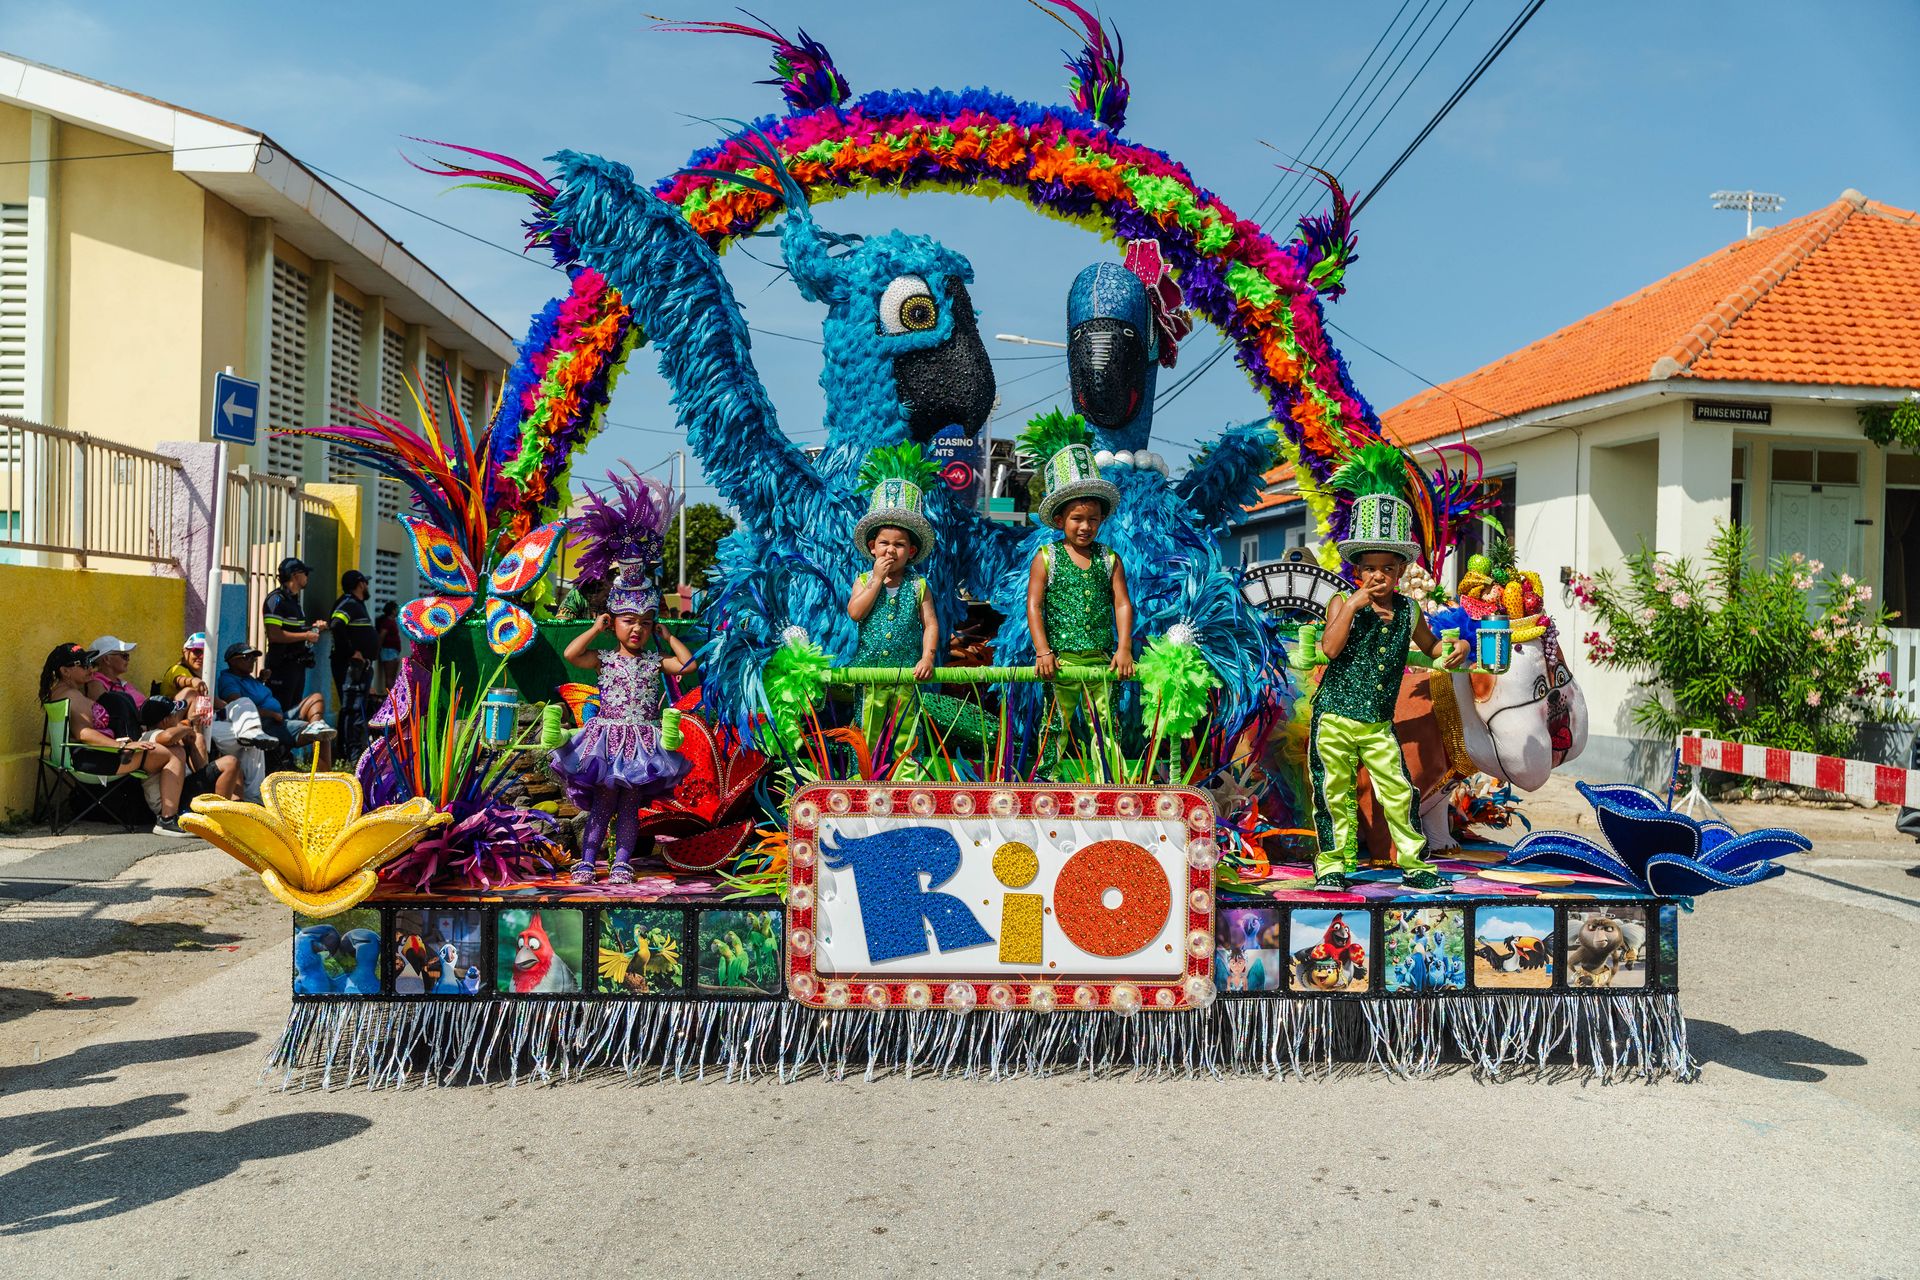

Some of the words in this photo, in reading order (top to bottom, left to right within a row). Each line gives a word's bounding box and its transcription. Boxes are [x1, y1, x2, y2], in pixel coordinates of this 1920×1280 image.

[1698, 407, 1769, 421] PRINSENSTRAAT
[938, 438, 974, 447] CASINO
[934, 448, 954, 457] NTS
